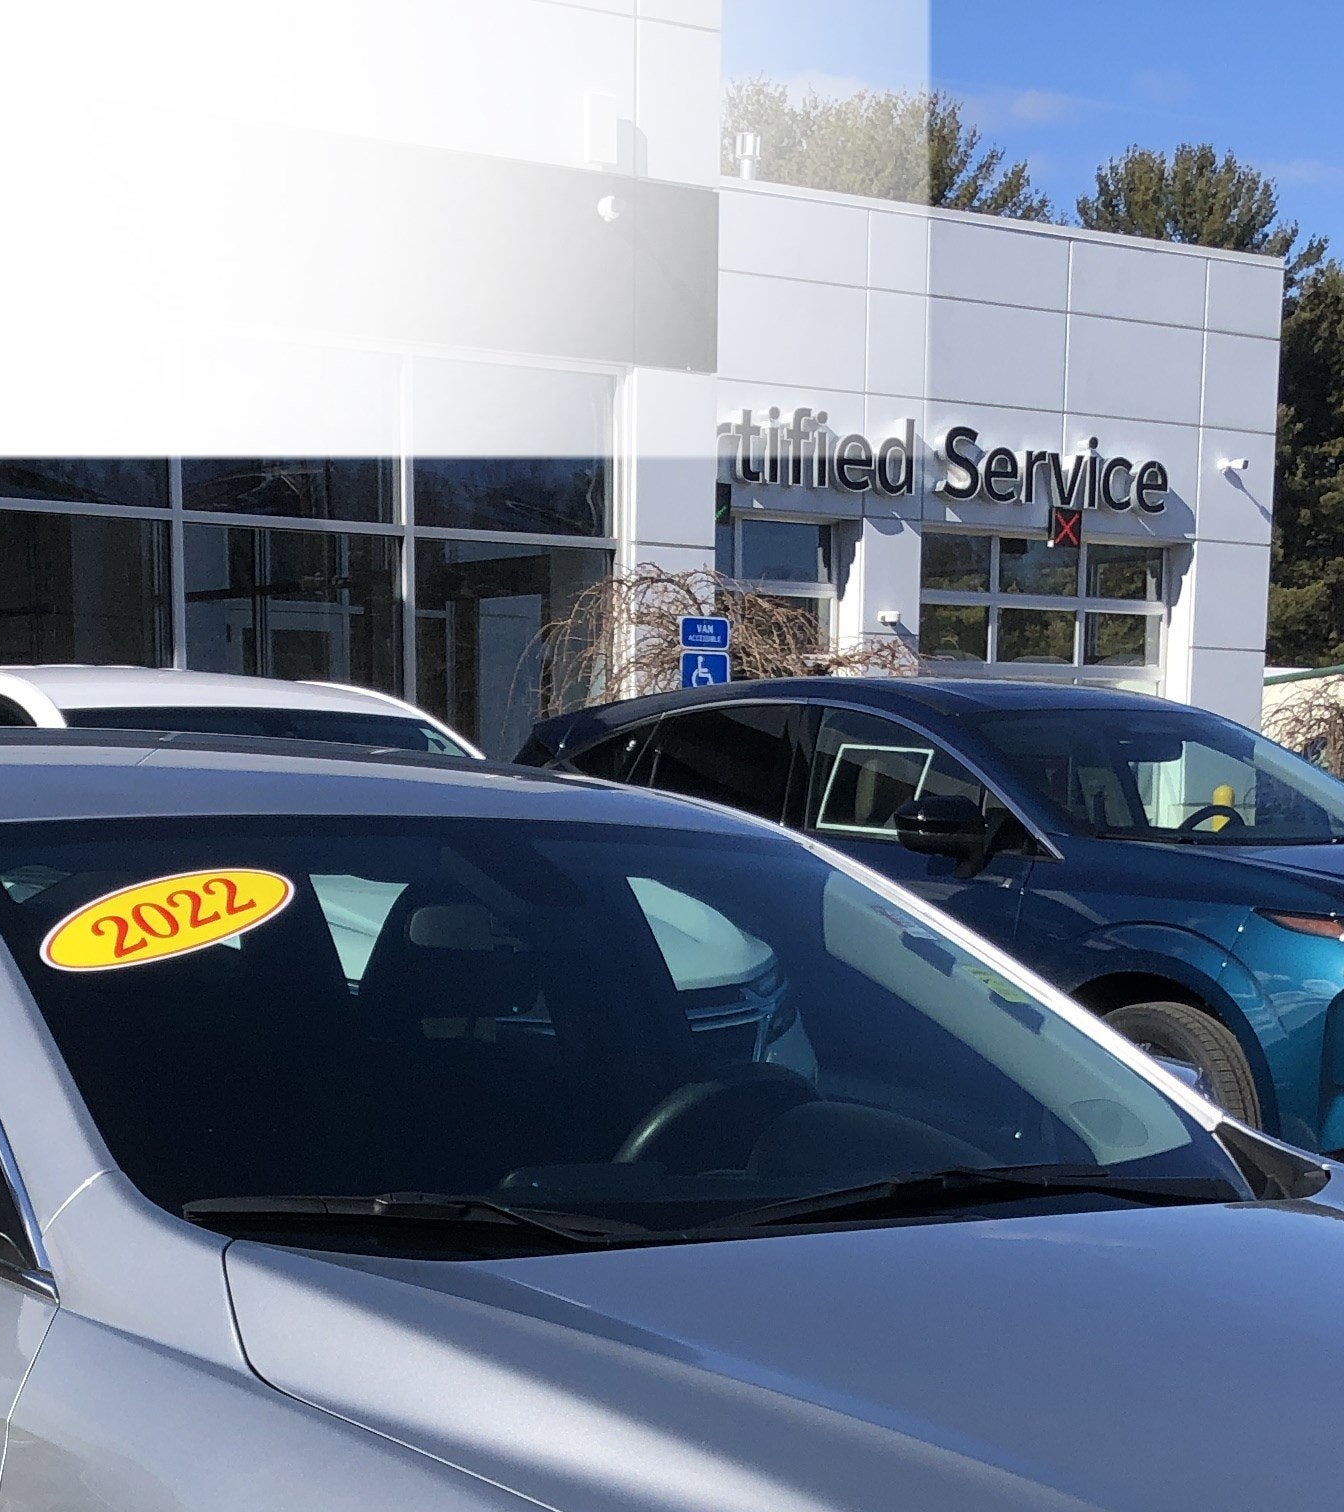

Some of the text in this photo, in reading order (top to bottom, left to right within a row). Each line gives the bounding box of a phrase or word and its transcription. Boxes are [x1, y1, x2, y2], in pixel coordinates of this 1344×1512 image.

[936, 425, 1170, 515] Service
[696, 623, 714, 634] VAN
[91, 878, 257, 958] 2022
